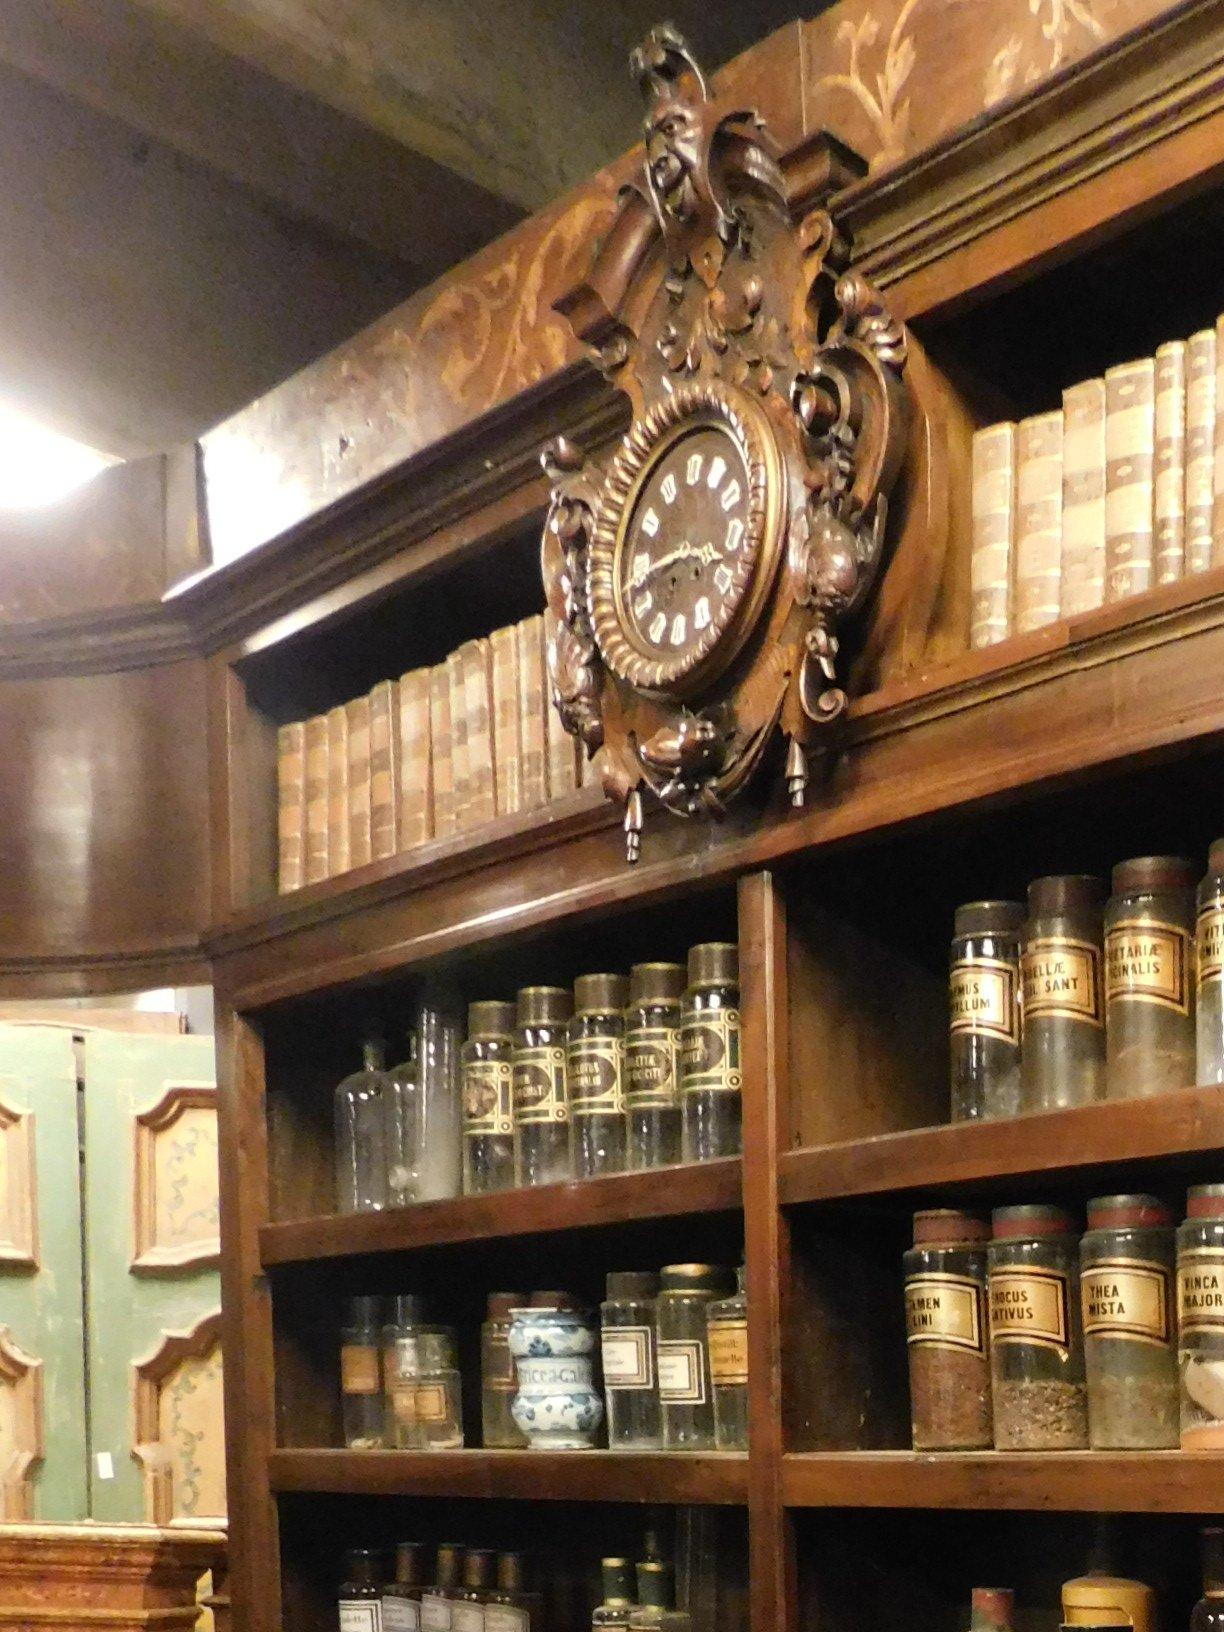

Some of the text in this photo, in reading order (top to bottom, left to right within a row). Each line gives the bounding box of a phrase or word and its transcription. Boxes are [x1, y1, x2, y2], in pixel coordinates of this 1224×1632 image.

[1184, 1275, 1220, 1291] VINCA
[1089, 1284, 1121, 1300] THEA
[1088, 1302, 1127, 1317] MISTA
[1183, 1294, 1224, 1310] MAJOR
